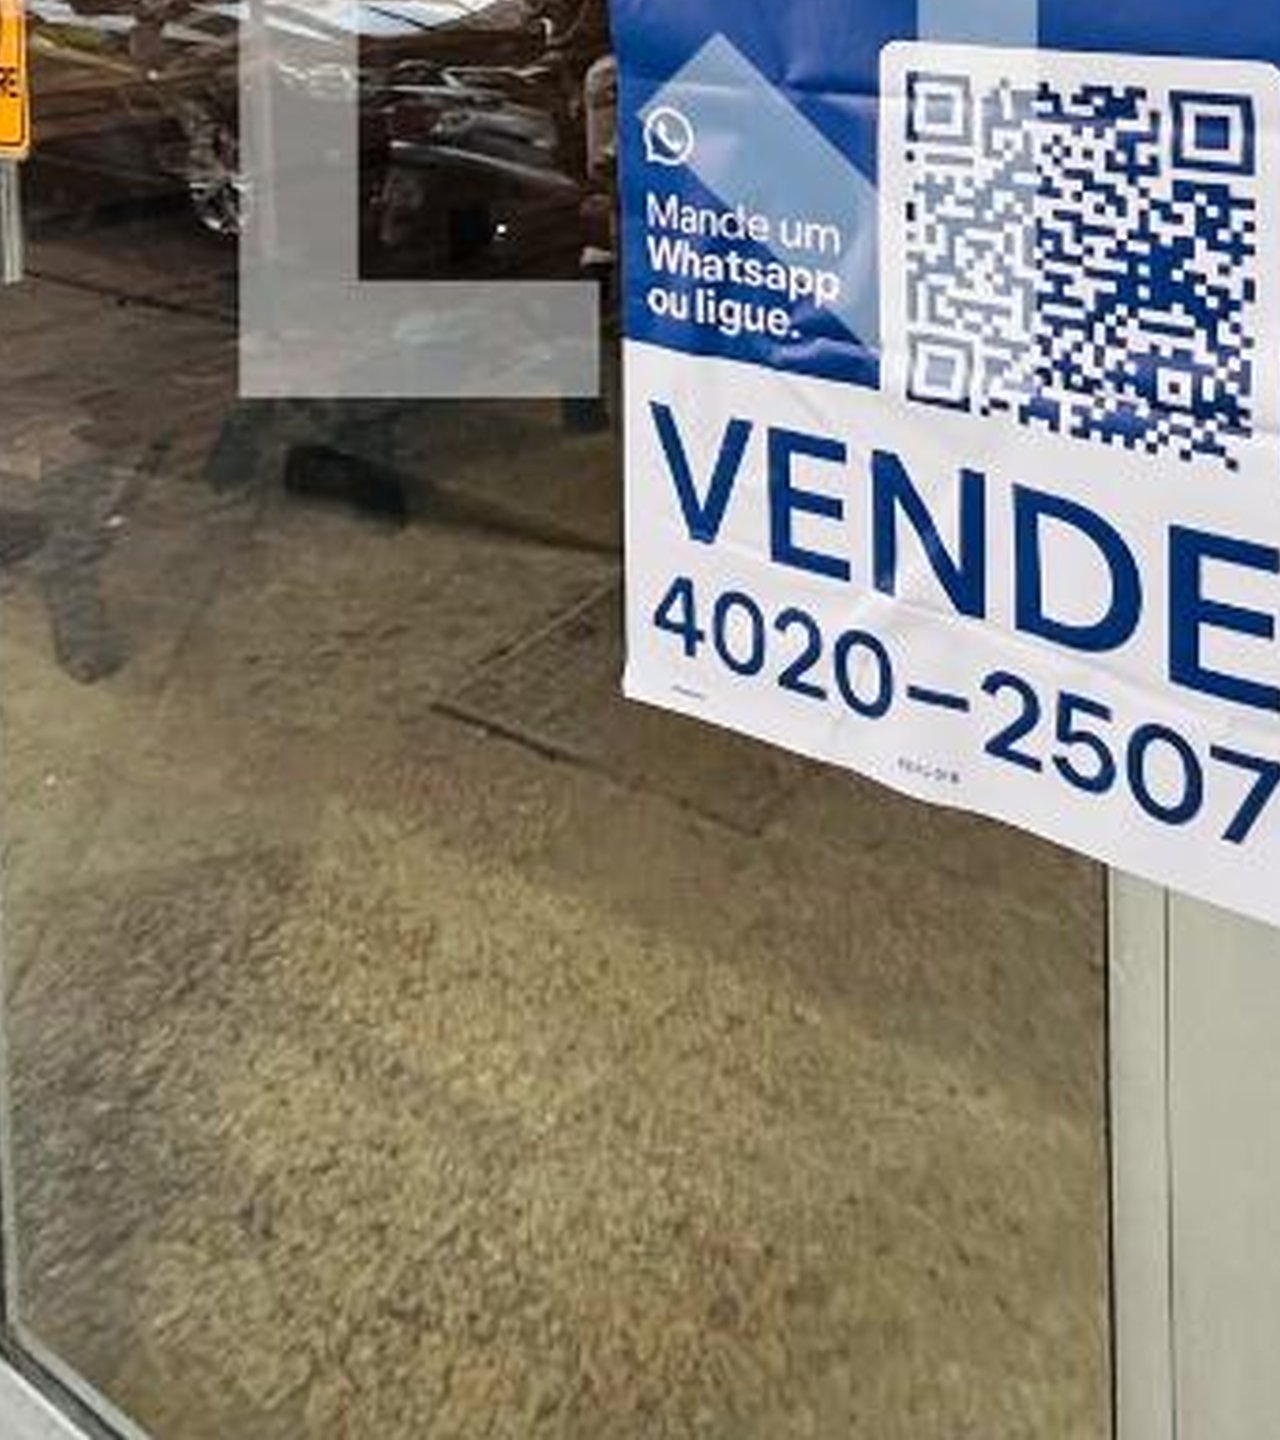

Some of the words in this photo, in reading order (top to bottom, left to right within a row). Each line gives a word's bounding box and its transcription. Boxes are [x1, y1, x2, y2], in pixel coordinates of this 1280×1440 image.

[646, 191, 770, 241] Mande
[780, 218, 841, 257] um
[646, 235, 842, 309] Whatsapp
[647, 288, 688, 321] ou
[695, 289, 802, 338] ligue.
